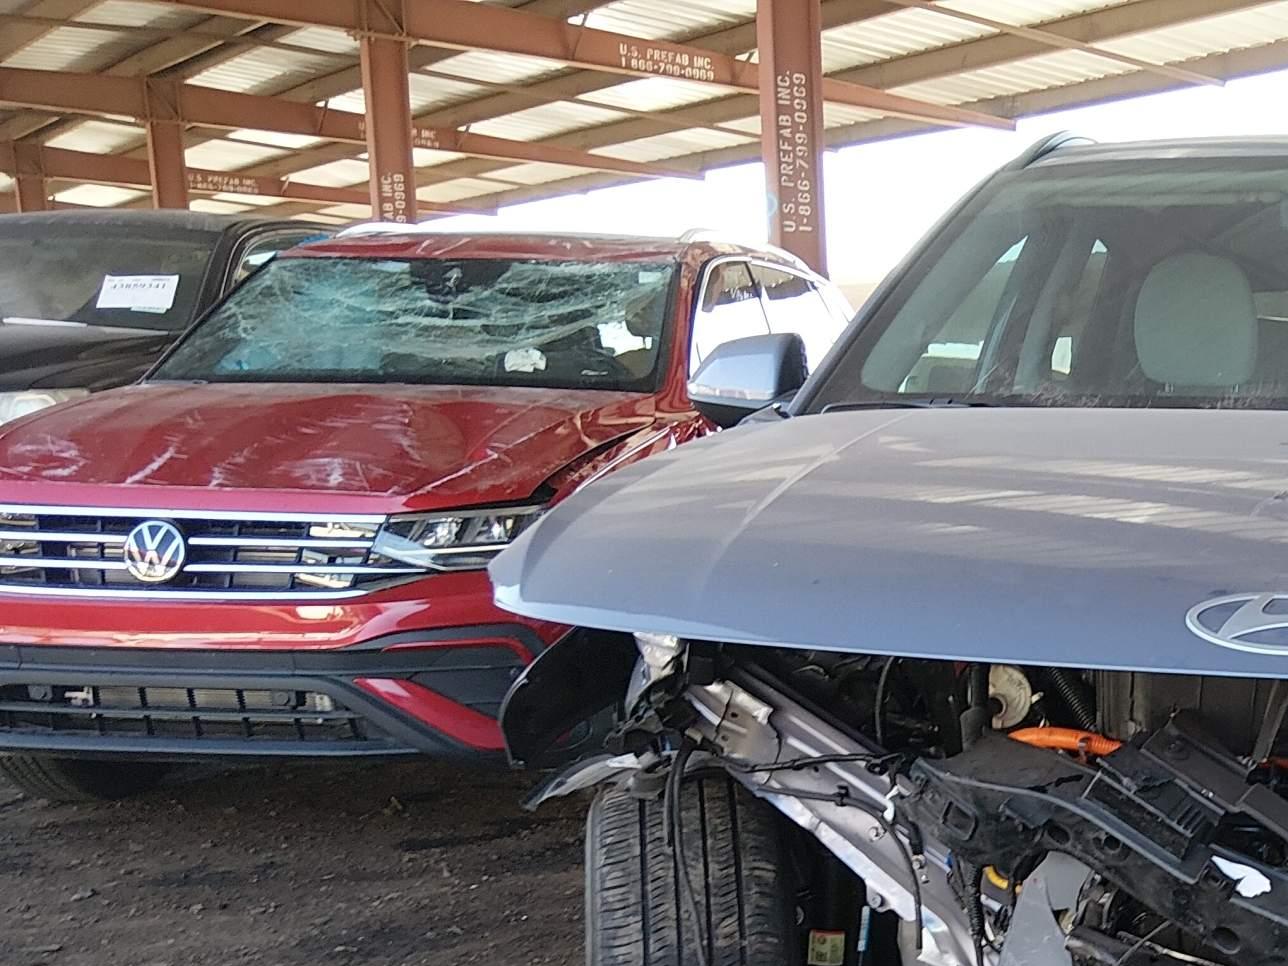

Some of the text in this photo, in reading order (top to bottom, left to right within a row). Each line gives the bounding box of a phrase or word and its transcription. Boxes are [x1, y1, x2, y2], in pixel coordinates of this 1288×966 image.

[619, 43, 715, 70] U.S. PREFAB INC.
[776, 70, 796, 232] U.S. PREFAB INC.
[792, 73, 813, 232] 1-866-799-0969
